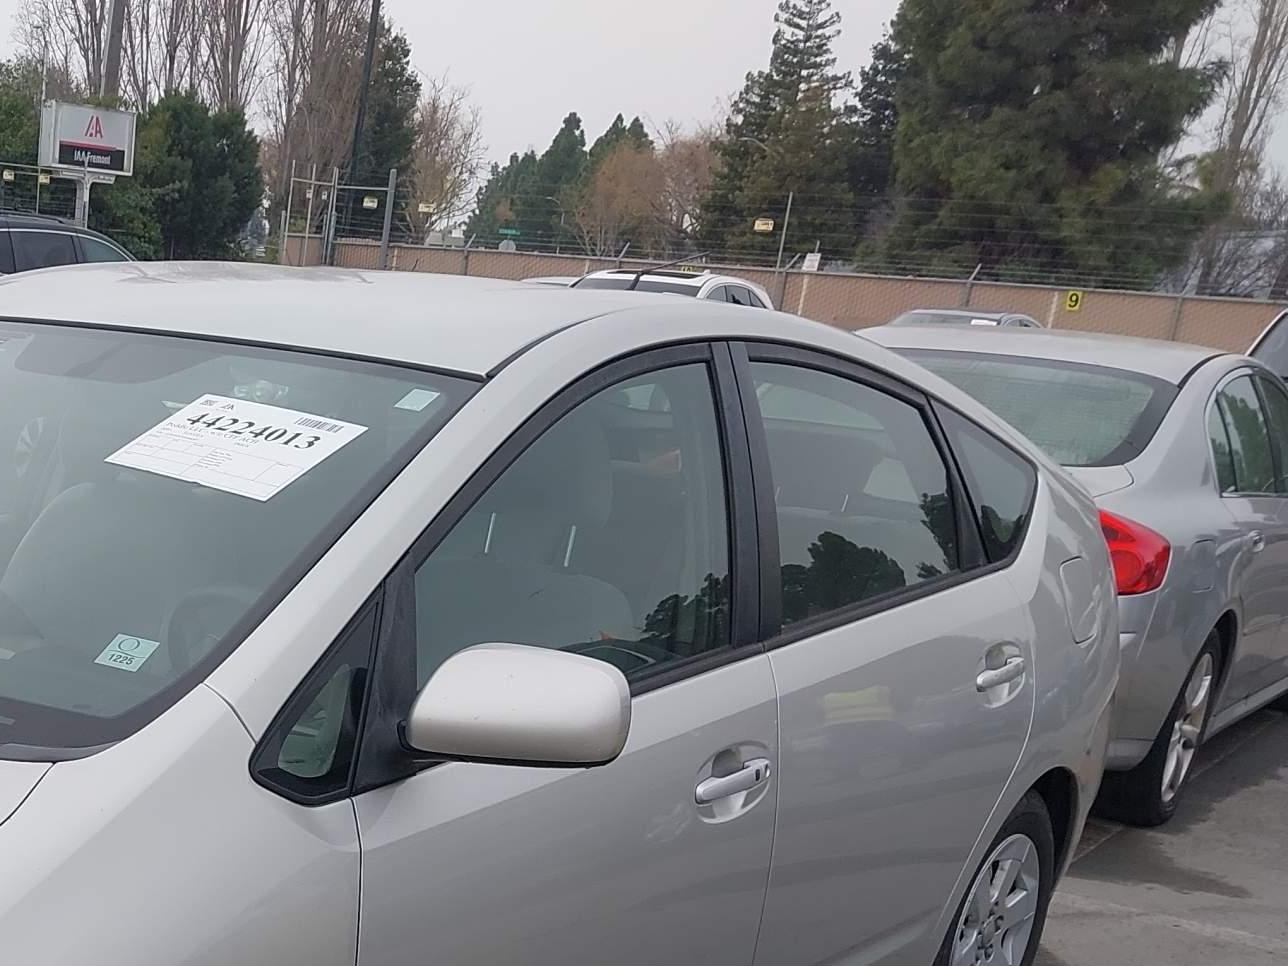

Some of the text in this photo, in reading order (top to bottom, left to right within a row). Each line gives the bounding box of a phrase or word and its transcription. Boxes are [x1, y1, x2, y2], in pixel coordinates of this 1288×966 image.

[1068, 292, 1080, 309] 9
[186, 412, 321, 450] 44224013
[108, 653, 136, 666] 1225
